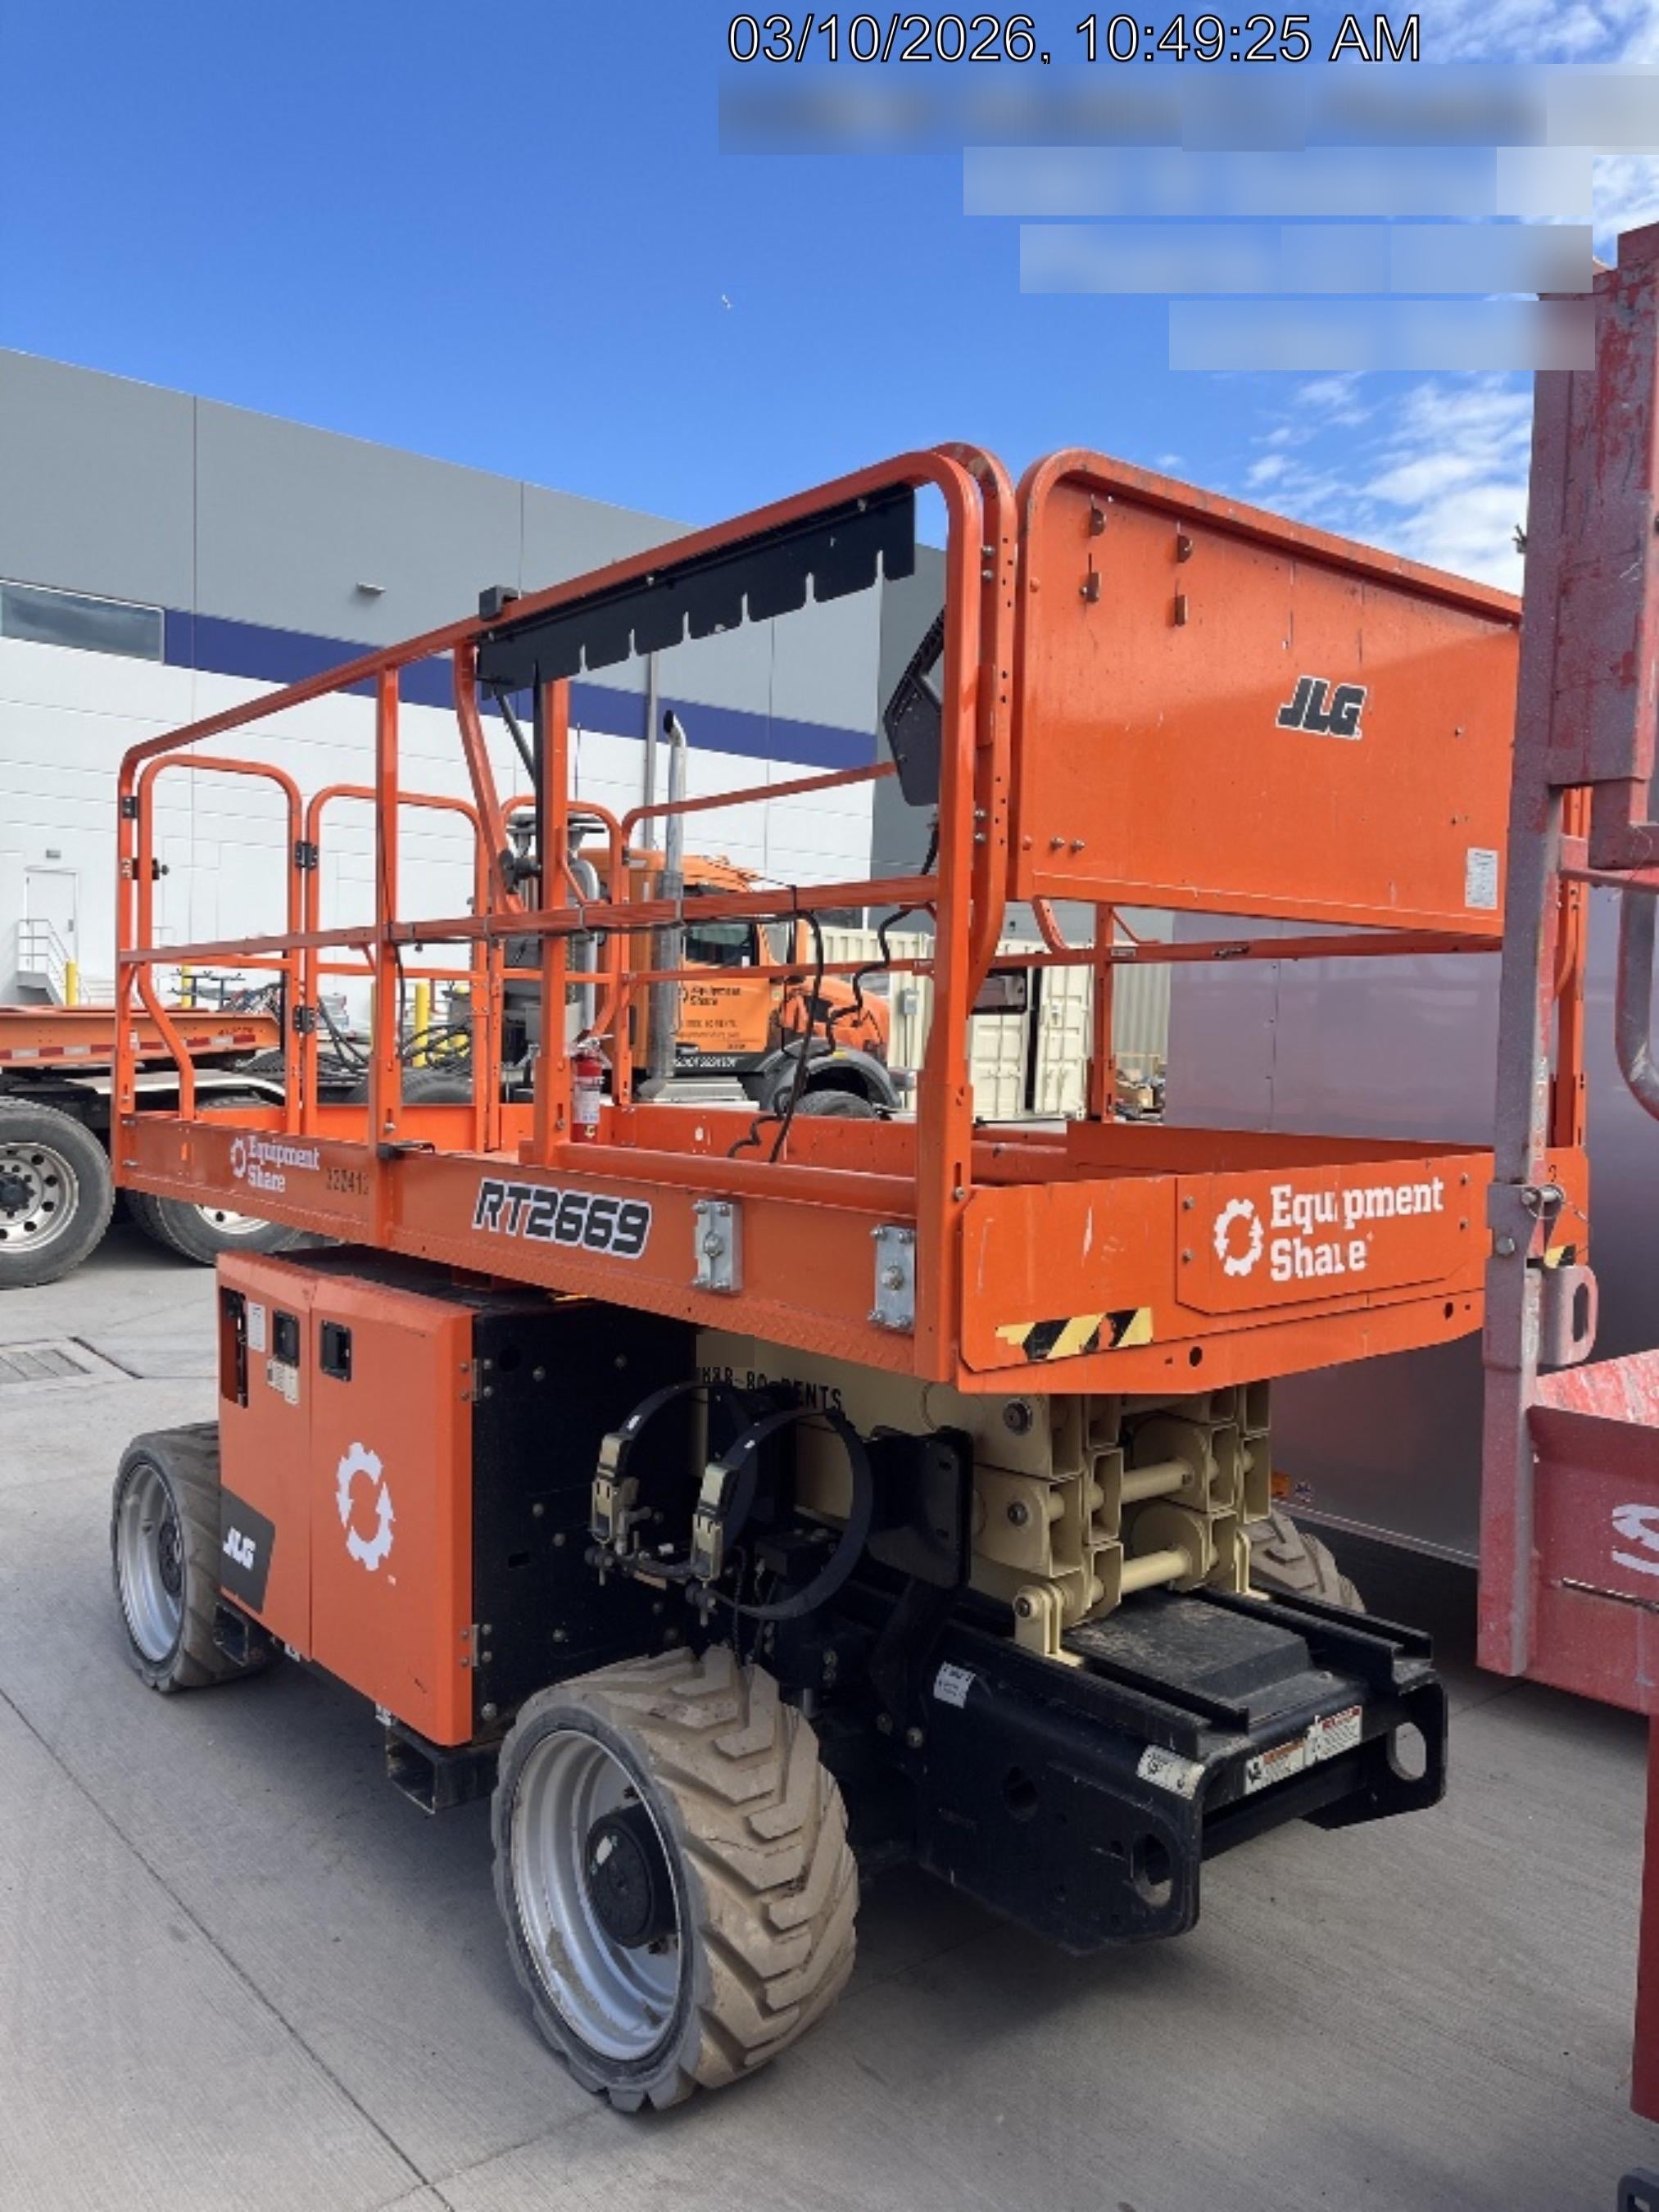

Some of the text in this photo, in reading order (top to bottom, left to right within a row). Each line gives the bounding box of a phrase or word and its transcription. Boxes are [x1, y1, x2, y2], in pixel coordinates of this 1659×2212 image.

[1276, 675, 1367, 740] JLG
[247, 1135, 320, 1171] Equipment
[247, 1164, 286, 1193] Share
[473, 1176, 652, 1259] RT2669
[223, 1525, 256, 1571] JLG
